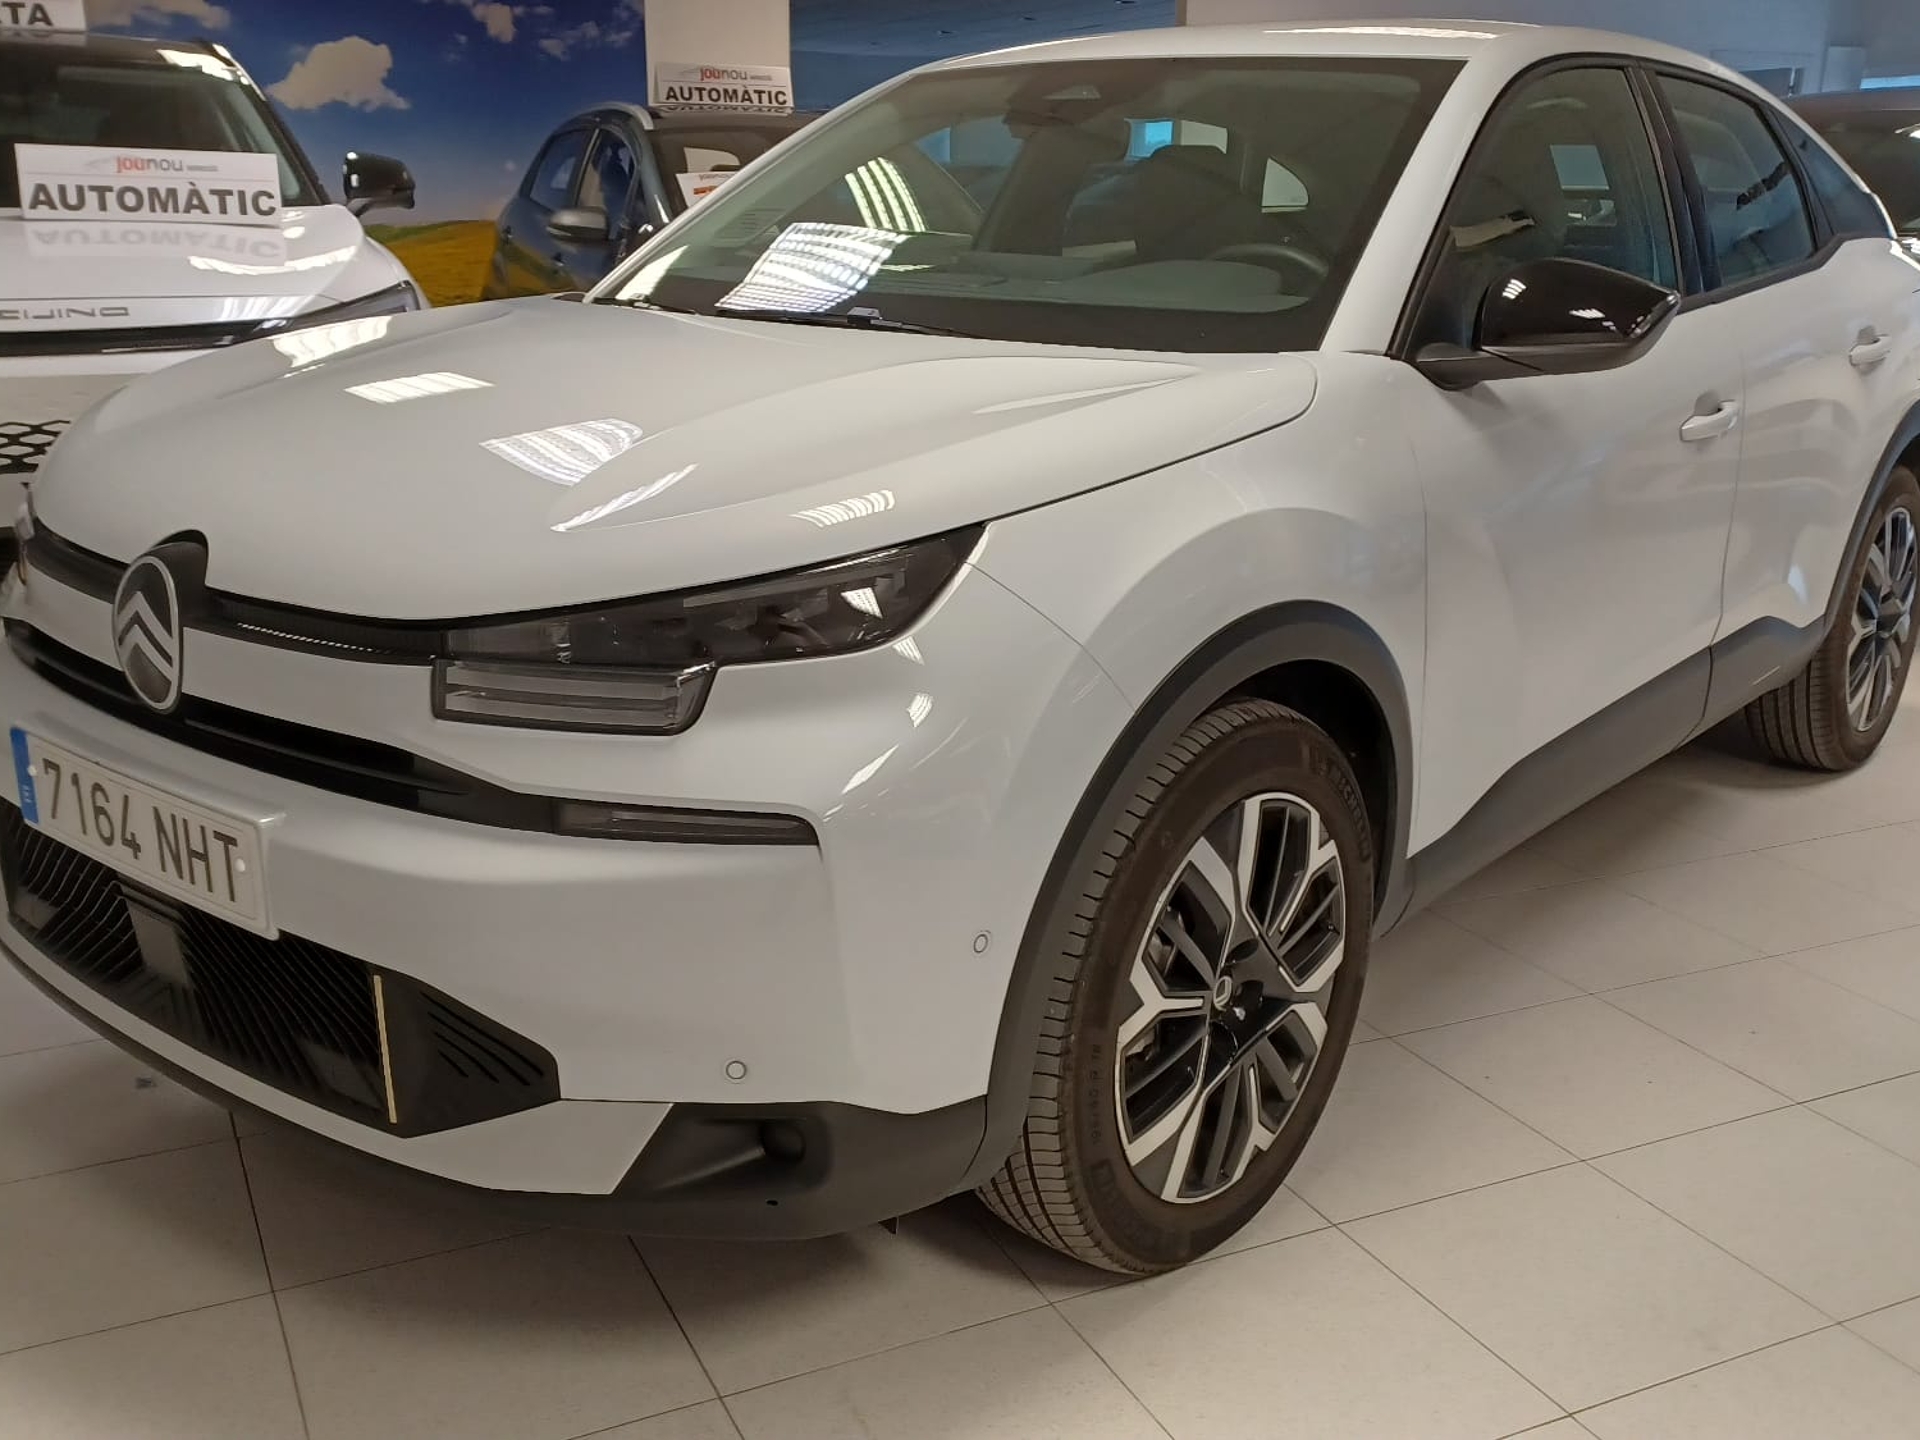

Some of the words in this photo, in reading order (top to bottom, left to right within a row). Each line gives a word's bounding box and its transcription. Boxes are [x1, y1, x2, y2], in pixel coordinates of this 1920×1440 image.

[665, 84, 788, 105] AUTOMÀTIC
[116, 156, 184, 174] jounou
[28, 181, 276, 216] AUTOMÀTIC
[42, 757, 141, 860] 7164
[153, 806, 238, 902] NHT
